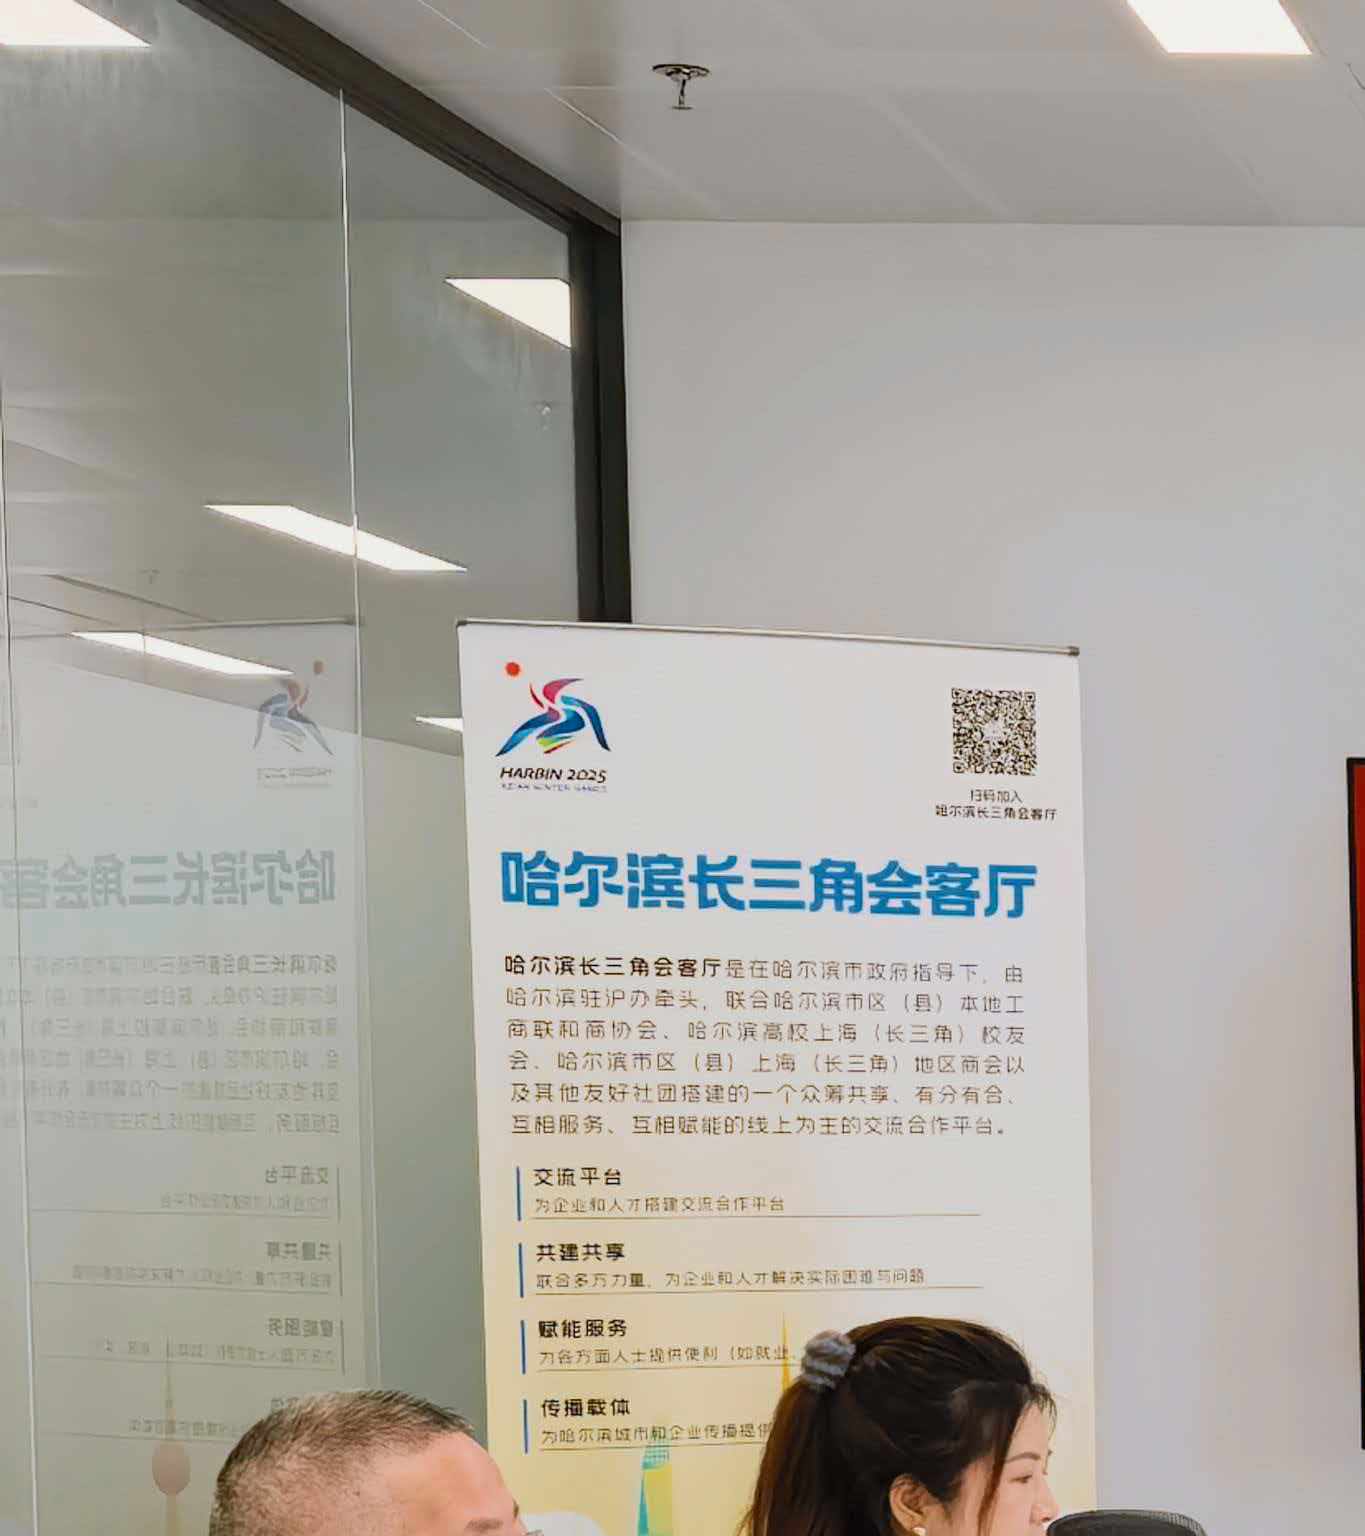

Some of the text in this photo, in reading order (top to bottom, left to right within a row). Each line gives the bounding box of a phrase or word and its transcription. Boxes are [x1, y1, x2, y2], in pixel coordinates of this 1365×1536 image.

[500, 767, 607, 784] HARBIN 2025
[970, 789, 1023, 803] 扫码加入
[936, 805, 1057, 821] 哈尔滨长三角会客厅
[501, 850, 1037, 918] 哈尔滨长三角会客厅
[534, 1167, 623, 1188] 交流平台
[535, 1196, 785, 1214] 为企业和人才搭建交流合作平台
[536, 1243, 626, 1262] 共建共享
[538, 1319, 628, 1339] 赋能服务
[541, 1398, 631, 1417] 传播载体
